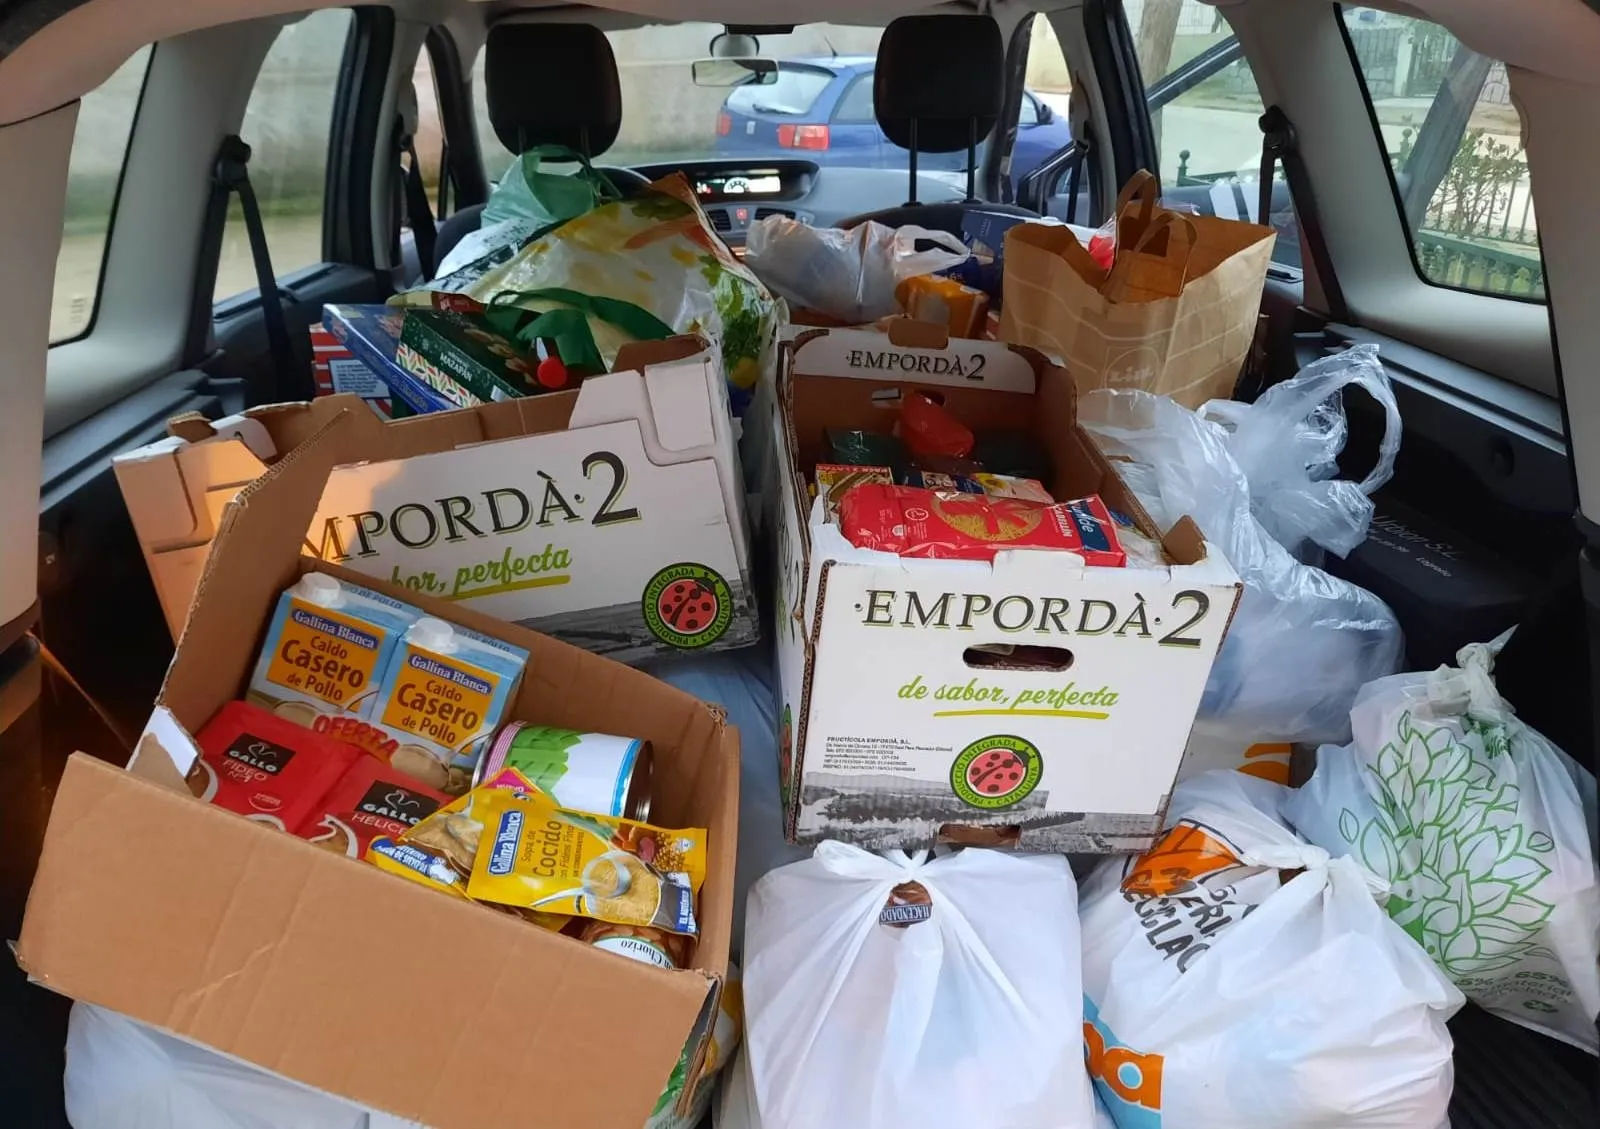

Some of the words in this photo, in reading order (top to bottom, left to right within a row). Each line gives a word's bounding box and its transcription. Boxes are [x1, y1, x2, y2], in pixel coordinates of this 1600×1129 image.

[391, 565, 448, 593] bor,
[452, 543, 572, 597] perfecta
[648, 567, 695, 600] INTEGRADA
[295, 610, 336, 635] Gallina
[337, 625, 375, 648] Blanca
[310, 635, 348, 659] Caldo
[281, 639, 364, 688] Casero
[411, 655, 452, 682] Gallina
[452, 671, 489, 694] Blanca
[286, 672, 302, 687] de
[305, 674, 344, 701] Pollo
[426, 679, 463, 702] Caldo
[898, 675, 928, 700] de
[934, 678, 1010, 704] sabor,
[1010, 682, 1120, 711] perfecta
[397, 683, 478, 730] Casero
[402, 715, 417, 729] de
[419, 717, 456, 744] Pollo
[224, 759, 269, 782] FIDEO
[229, 750, 278, 772] GALLO
[351, 812, 408, 835] HÉLICE
[362, 803, 420, 825] GALLO
[532, 820, 562, 878] Cocido
[880, 905, 930, 921] HACENDADO
[620, 940, 663, 965] Chorizo
